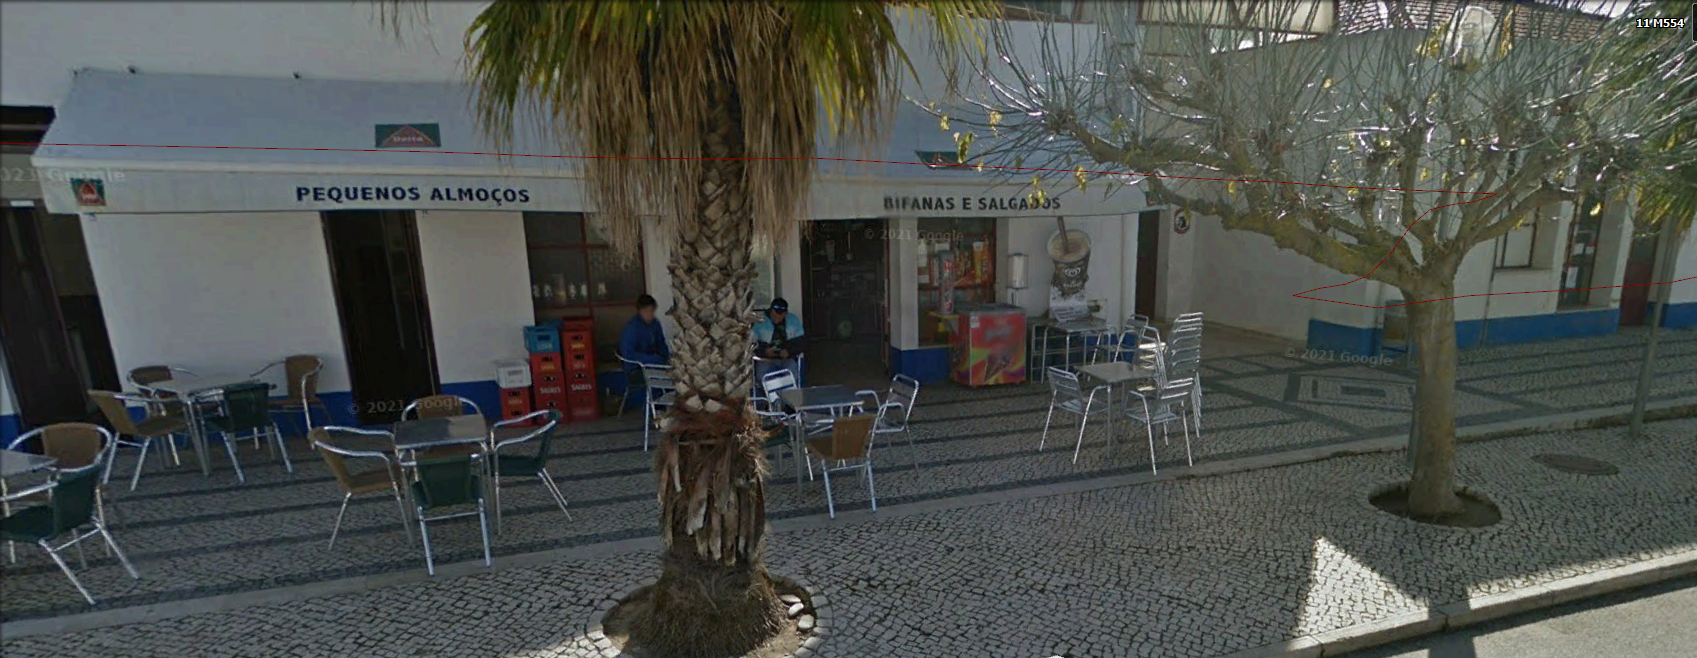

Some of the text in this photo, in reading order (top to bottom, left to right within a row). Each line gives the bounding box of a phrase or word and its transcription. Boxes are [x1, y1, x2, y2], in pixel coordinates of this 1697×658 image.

[296, 186, 530, 206] PEQUENOS ALMOÇOS
[883, 196, 956, 211] BIFANAS
[962, 197, 973, 210] E
